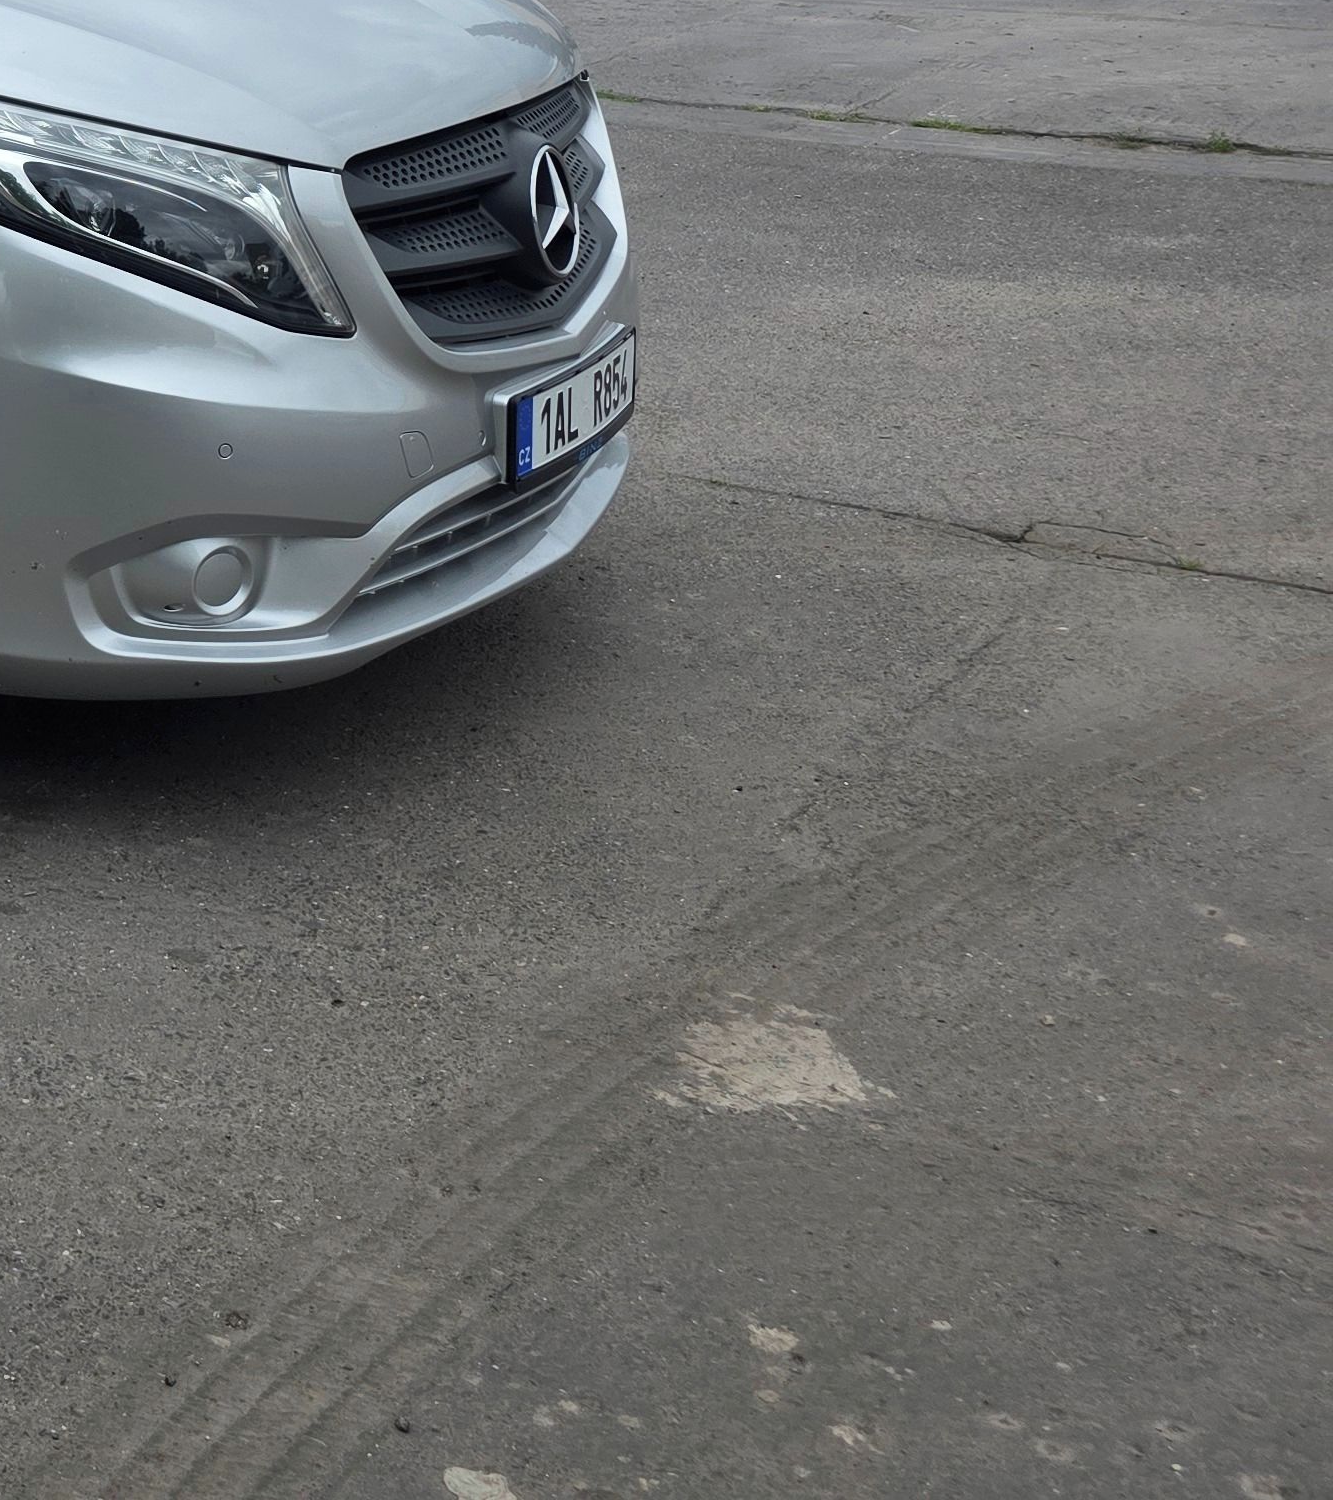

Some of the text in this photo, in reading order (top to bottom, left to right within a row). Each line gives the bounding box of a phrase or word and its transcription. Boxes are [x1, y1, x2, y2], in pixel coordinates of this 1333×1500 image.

[540, 348, 628, 455] 1AL R854
[518, 445, 531, 467] CZ
